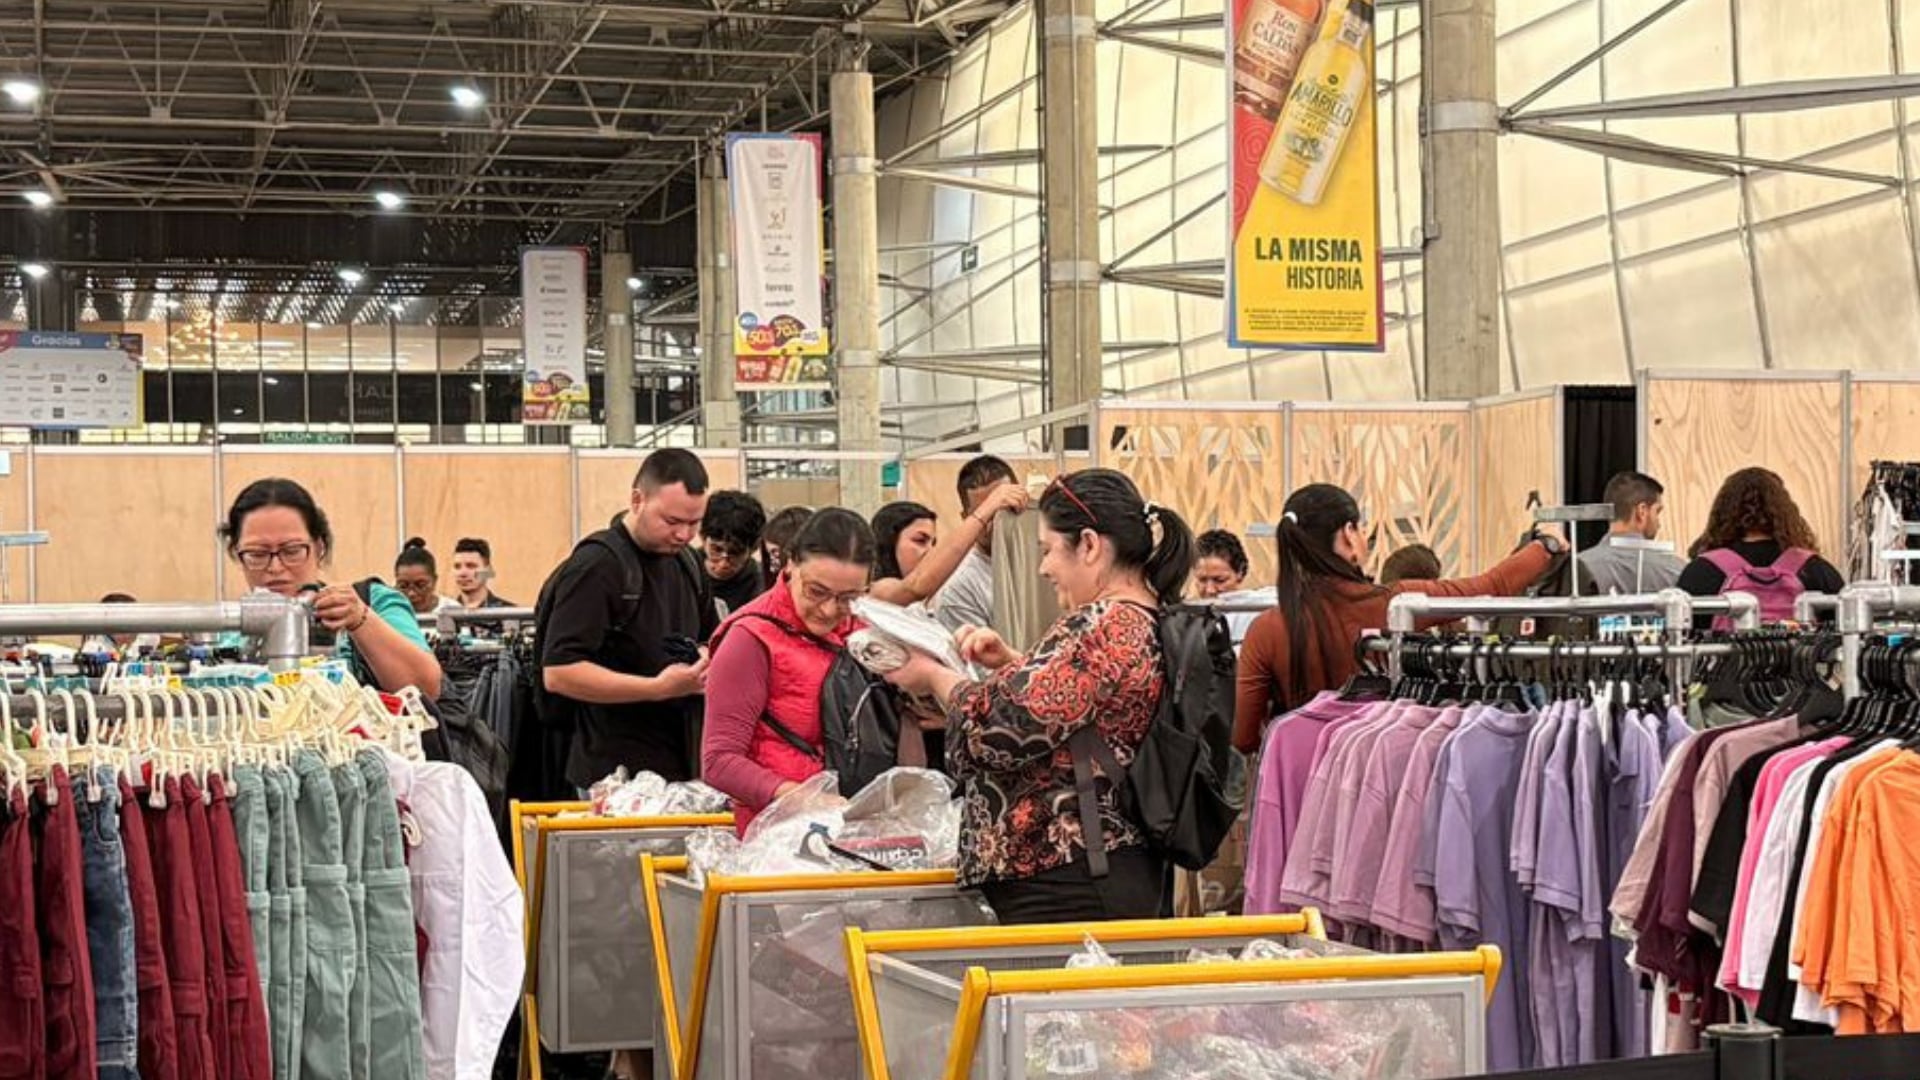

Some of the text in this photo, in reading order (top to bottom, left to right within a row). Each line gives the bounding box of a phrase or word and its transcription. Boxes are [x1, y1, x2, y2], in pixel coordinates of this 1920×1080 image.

[1290, 81, 1353, 127] AMARILLO
[1255, 237, 1362, 263] LA MISMA
[1286, 265, 1364, 291] HISTORIA
